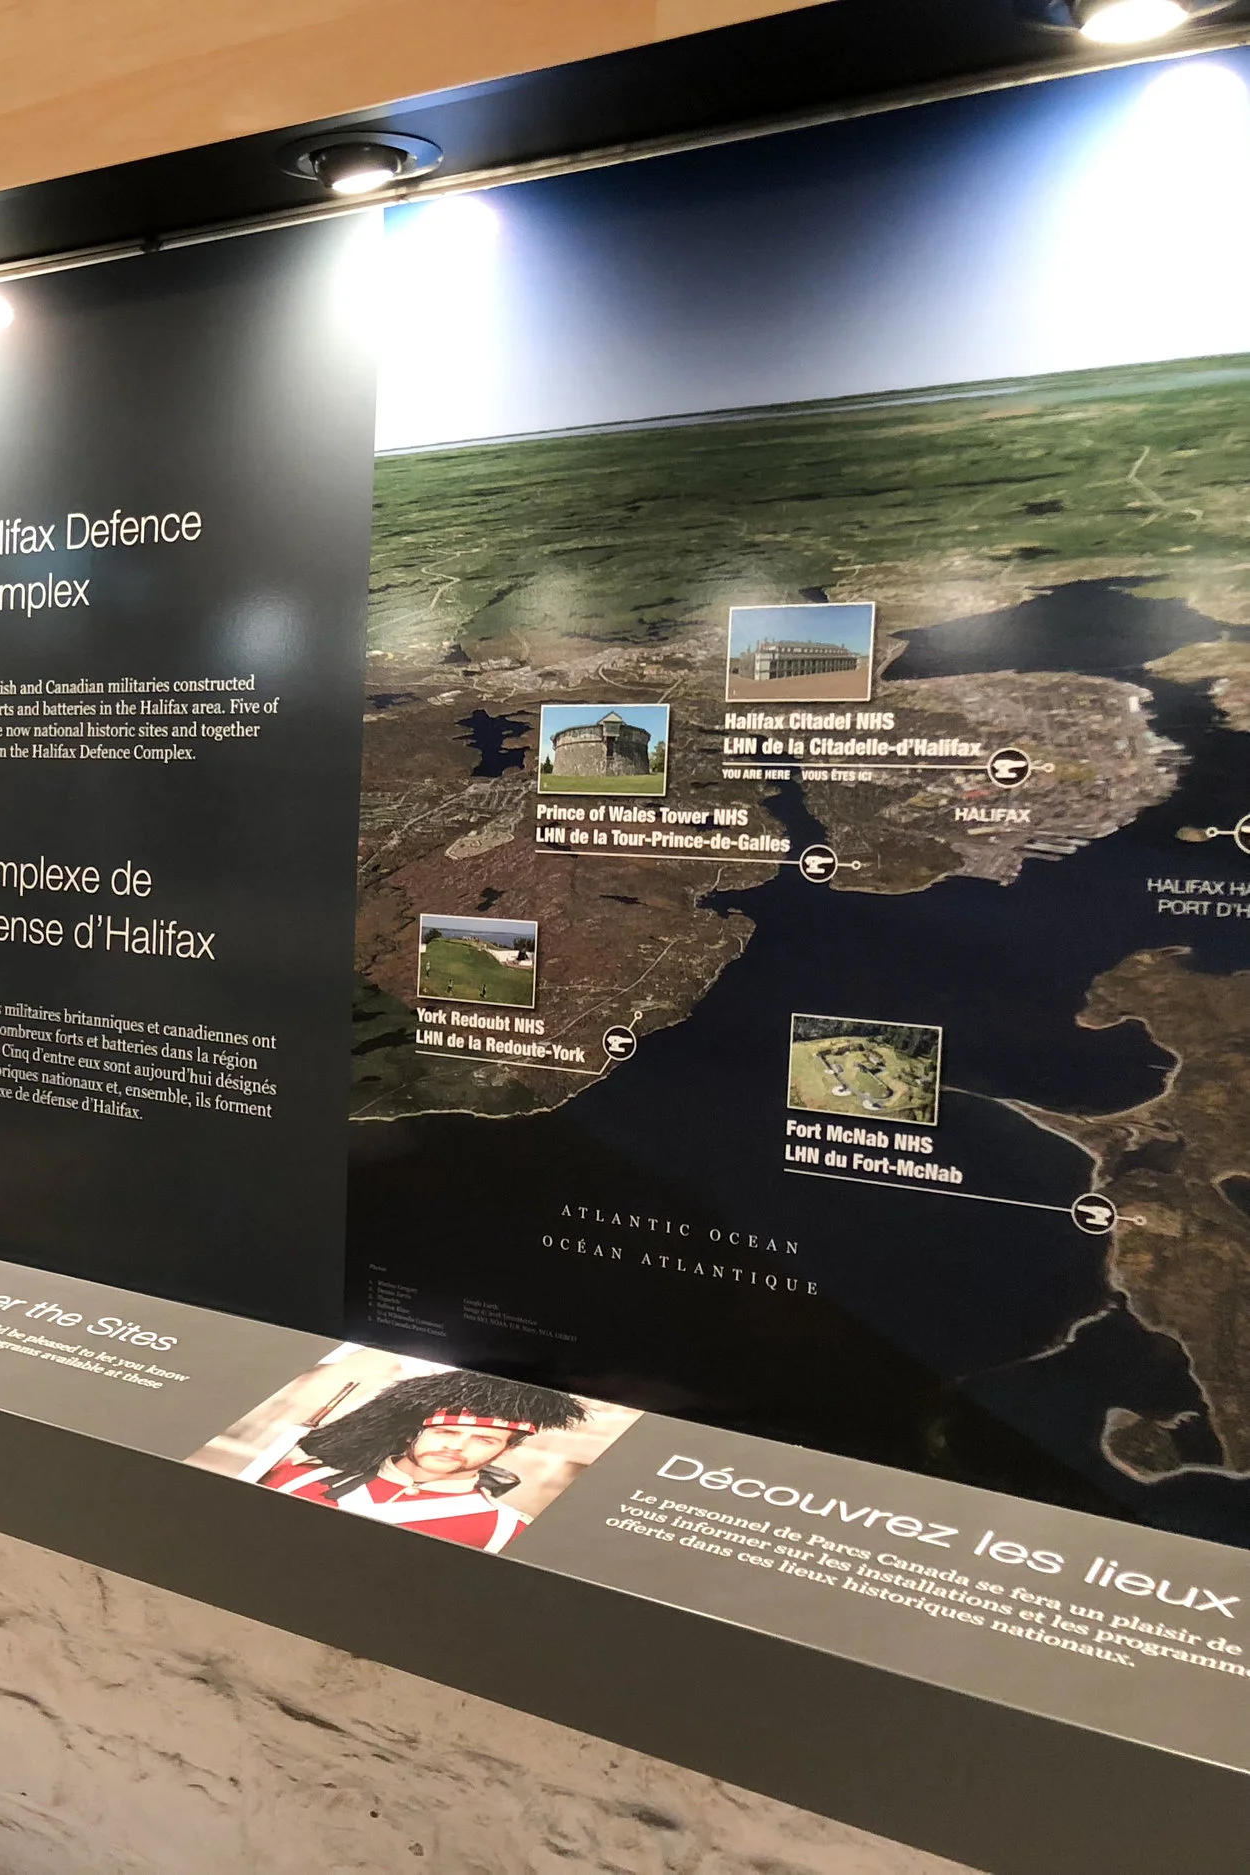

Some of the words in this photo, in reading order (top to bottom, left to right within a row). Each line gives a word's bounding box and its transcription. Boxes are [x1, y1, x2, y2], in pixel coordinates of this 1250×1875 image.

[66, 509, 201, 549] Defence
[20, 679, 42, 694] and
[45, 678, 104, 694] Canadian
[107, 677, 169, 693] militaries
[173, 673, 255, 692] constructed
[17, 701, 39, 715] and
[42, 700, 96, 715] batteries
[99, 700, 112, 715] in
[115, 699, 136, 715] the
[140, 699, 188, 715] Halifax
[192, 703, 225, 714] area.
[230, 698, 259, 714] Five
[263, 697, 279, 713] of
[725, 714, 785, 731] Halifax
[789, 712, 852, 730] Citadel
[857, 713, 894, 730] NHS
[6, 726, 31, 737] now
[33, 721, 83, 737] national
[87, 722, 135, 737] historic
[138, 722, 168, 737] sites
[171, 721, 197, 737] and
[201, 721, 260, 741] together
[723, 738, 757, 755] LHN
[762, 738, 779, 755] de
[784, 738, 804, 755] la
[809, 737, 982, 758] Citadelle-d'Halifax
[10, 743, 29, 758] the
[32, 743, 76, 758] Halifax
[79, 743, 130, 759] Defence
[133, 743, 195, 763] Complex.
[722, 769, 741, 780] YOU
[744, 770, 762, 780] ARE
[765, 770, 790, 781] HERE
[802, 770, 827, 781] VOUS
[858, 771, 872, 781] ICI
[536, 805, 586, 822] Prince
[590, 807, 604, 822] of
[607, 807, 656, 824] Wales
[660, 808, 709, 825] Tower
[714, 809, 749, 826] NHS
[955, 807, 1031, 823] HALIFAX
[536, 827, 565, 844] LHN
[570, 827, 587, 845] de
[592, 828, 608, 846] la
[612, 830, 790, 852] Tour-Prince-de-Galles
[111, 860, 151, 897] de
[1147, 878, 1225, 895] HALIFAX
[1158, 899, 1211, 915] PORT
[74, 914, 215, 960] d'Halifax
[4, 1003, 61, 1022] militaires
[64, 1008, 144, 1033] britanniques
[147, 1021, 159, 1034] et
[163, 1024, 248, 1045] canadiennes
[252, 1035, 276, 1049] ont
[417, 1008, 447, 1025] York
[451, 1011, 510, 1032] Redoubt
[515, 1018, 545, 1035] NHS
[55, 1028, 83, 1046] forts
[86, 1036, 98, 1048] et
[101, 1034, 158, 1056] batteries
[161, 1042, 193, 1061] dans
[196, 1046, 209, 1063] la
[212, 1050, 257, 1070] région
[416, 1030, 443, 1046] LHN
[448, 1034, 464, 1049] de
[468, 1038, 481, 1051] la
[486, 1038, 585, 1063] Redoute-York
[1, 1043, 29, 1063] Cinq
[32, 1047, 75, 1066] d'entre
[78, 1057, 100, 1070] eux
[103, 1061, 131, 1074] sont
[134, 1063, 211, 1086] aujourd'hui
[215, 1072, 277, 1095] désignés
[15, 1086, 30, 1101] de
[32, 1088, 78, 1109] défense
[81, 1096, 142, 1119] d'Halifax.
[786, 1120, 821, 1140] Fort
[827, 1125, 889, 1149] McNab
[895, 1134, 934, 1154] NHS
[785, 1145, 819, 1164] LHN
[825, 1150, 847, 1169] du
[853, 1154, 963, 1185] Fort-McNab
[561, 1204, 691, 1236] ATLANTIC
[709, 1229, 799, 1255] OCEAN
[542, 1234, 623, 1260] OCÉAN
[641, 1253, 819, 1296] ATLANTIQUE
[24, 1301, 83, 1326] the
[86, 1317, 177, 1350] Sites
[656, 1454, 959, 1548] Découvrez
[973, 1530, 1065, 1574] les
[1084, 1556, 1241, 1618] lieux
[620, 1504, 668, 1523] vous
[670, 1515, 771, 1549] informer
[773, 1545, 814, 1561] sur
[816, 1552, 851, 1571] les
[856, 1563, 1013, 1615] installations
[1018, 1610, 1046, 1624] et
[1050, 1614, 1089, 1635] les
[629, 1489, 657, 1504] Le
[657, 1499, 770, 1533] personnel
[773, 1526, 802, 1541] de
[805, 1534, 871, 1560] Parcs
[876, 1553, 969, 1586] Canada
[975, 1581, 1004, 1594] se
[1009, 1587, 1061, 1610] fera
[1069, 1604, 1104, 1622] un
[1108, 1615, 1202, 1645] plaisir
[1206, 1637, 1242, 1655] de
[605, 1515, 675, 1541] offerts
[679, 1535, 733, 1556] dans
[737, 1552, 774, 1568] ces
[777, 1559, 838, 1585] lieux
[841, 1576, 985, 1625] historiques
[989, 1620, 1135, 1667] nationaux.
